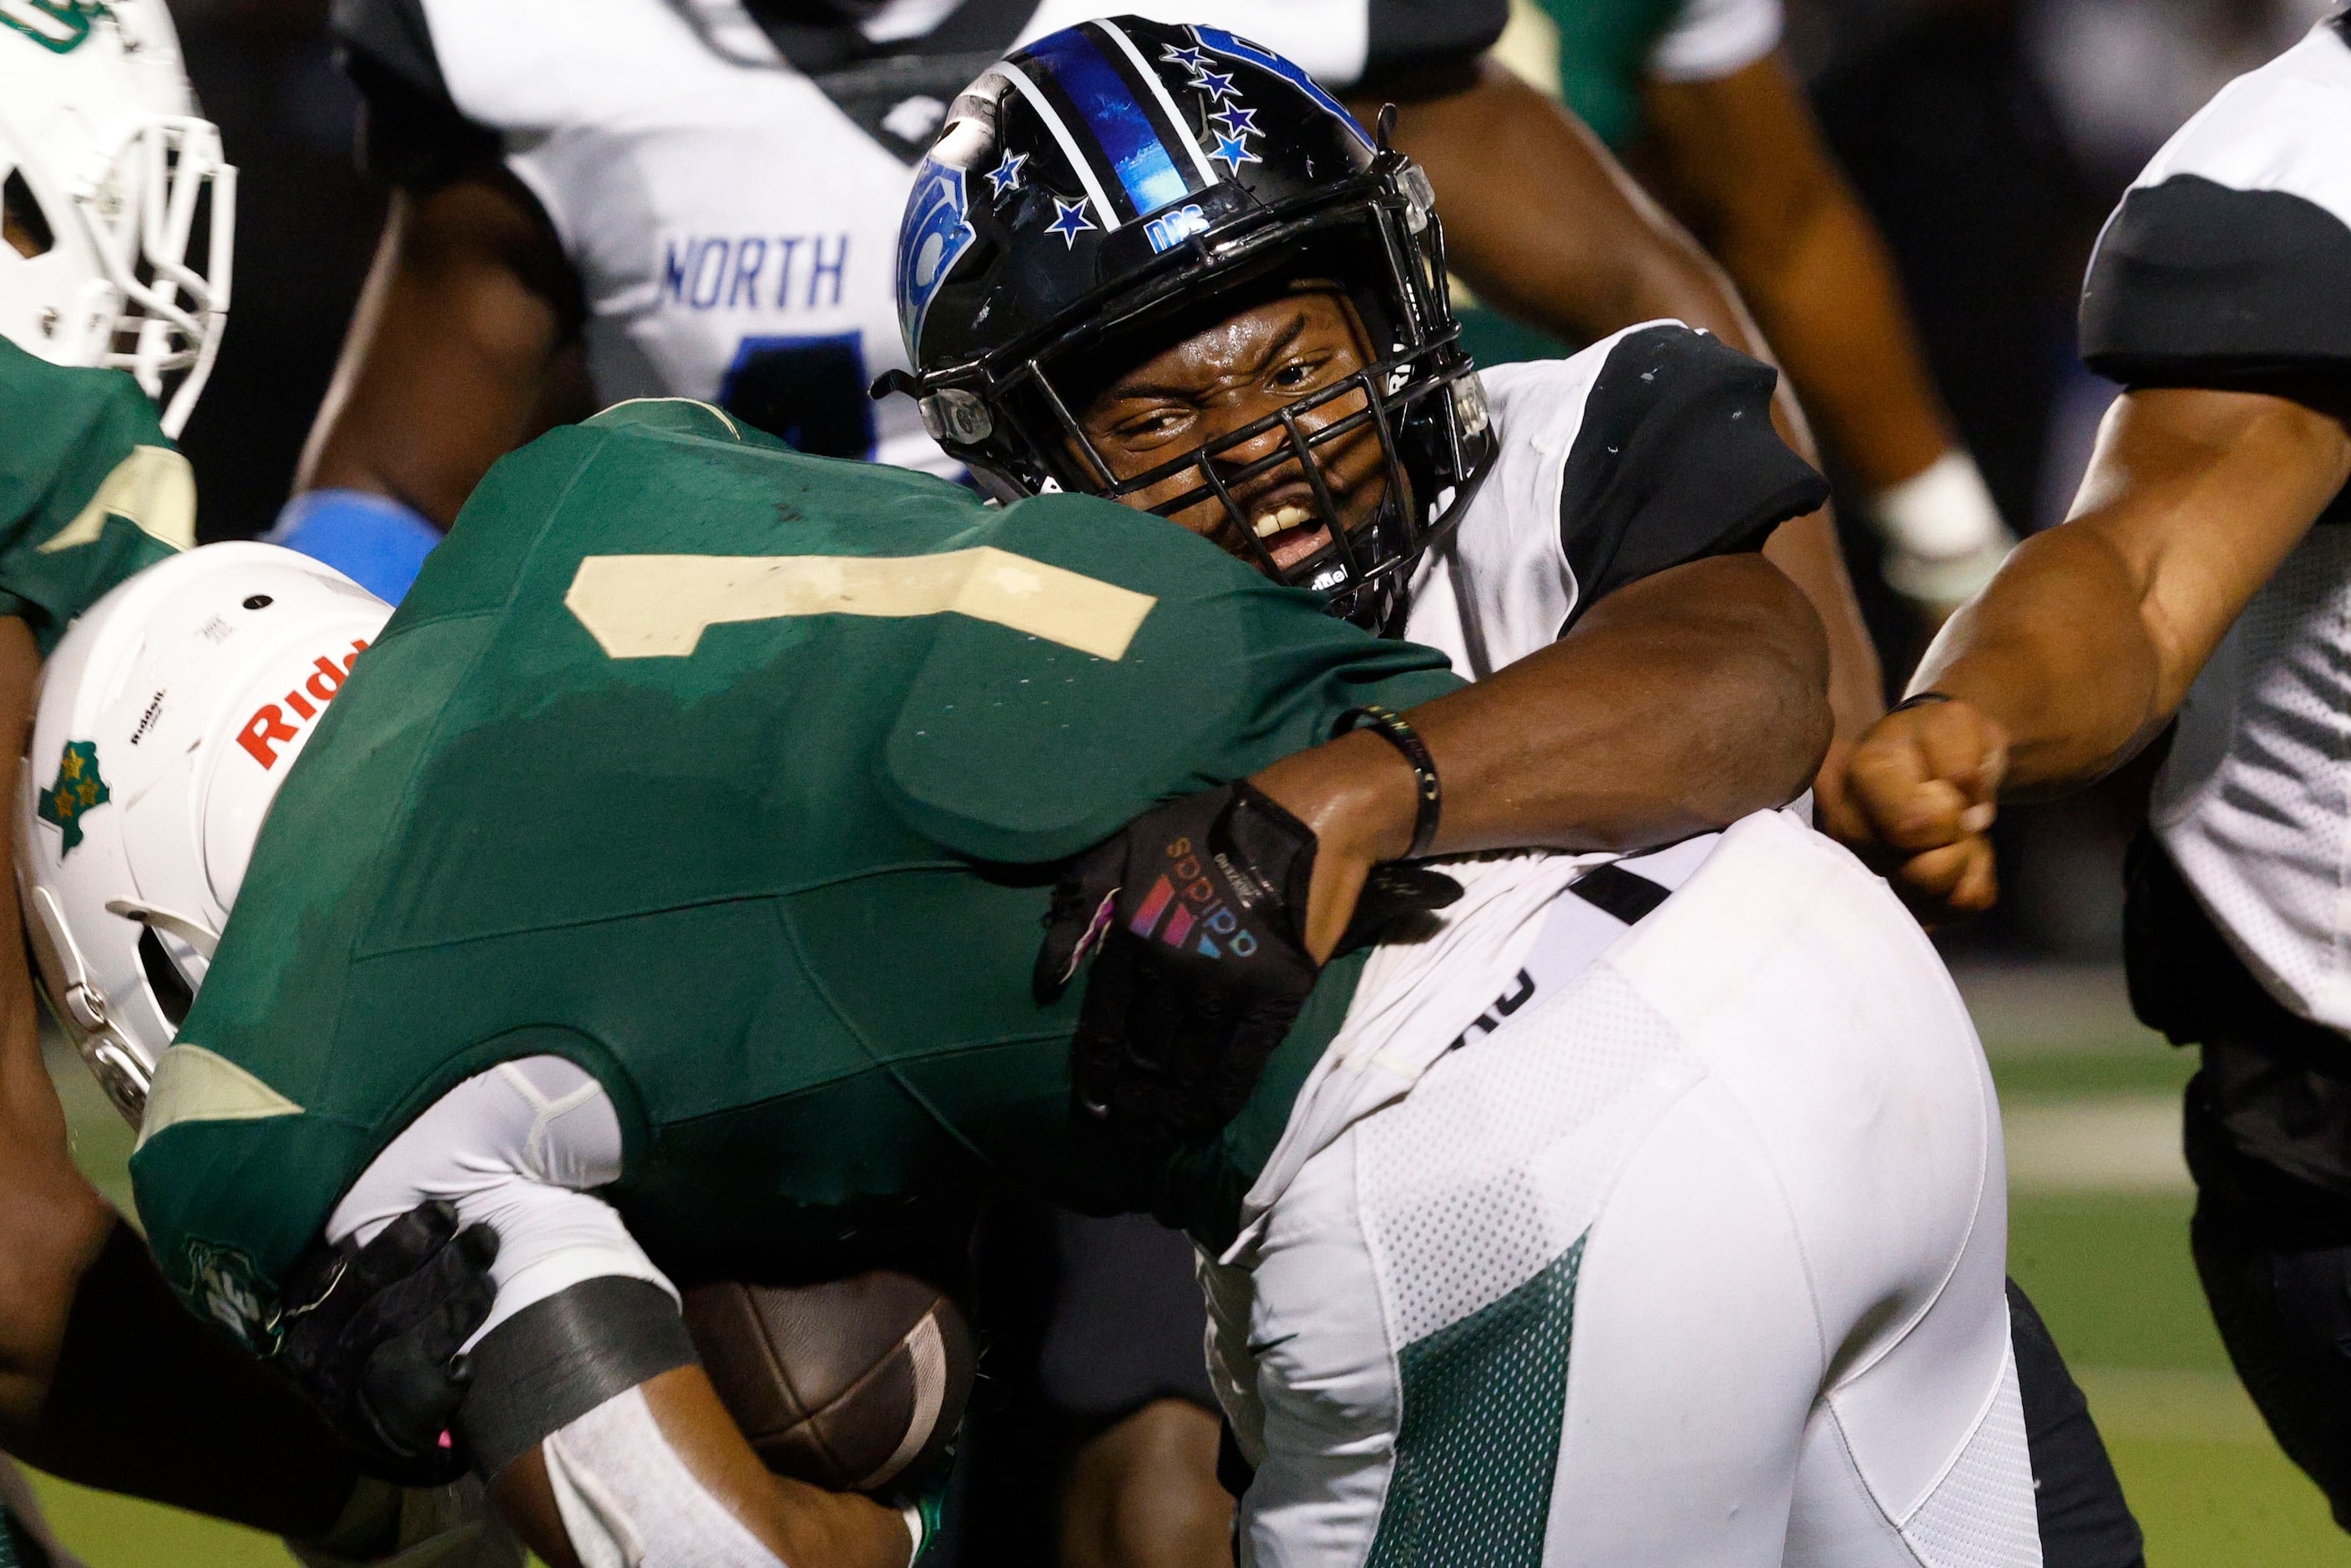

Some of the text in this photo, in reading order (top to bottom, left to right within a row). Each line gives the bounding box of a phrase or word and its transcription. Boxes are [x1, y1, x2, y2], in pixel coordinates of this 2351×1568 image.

[668, 234, 847, 310] NORTH
[564, 545, 1158, 661] 1
[131, 690, 164, 744] Riddell
[1166, 837, 1257, 957] adidas
